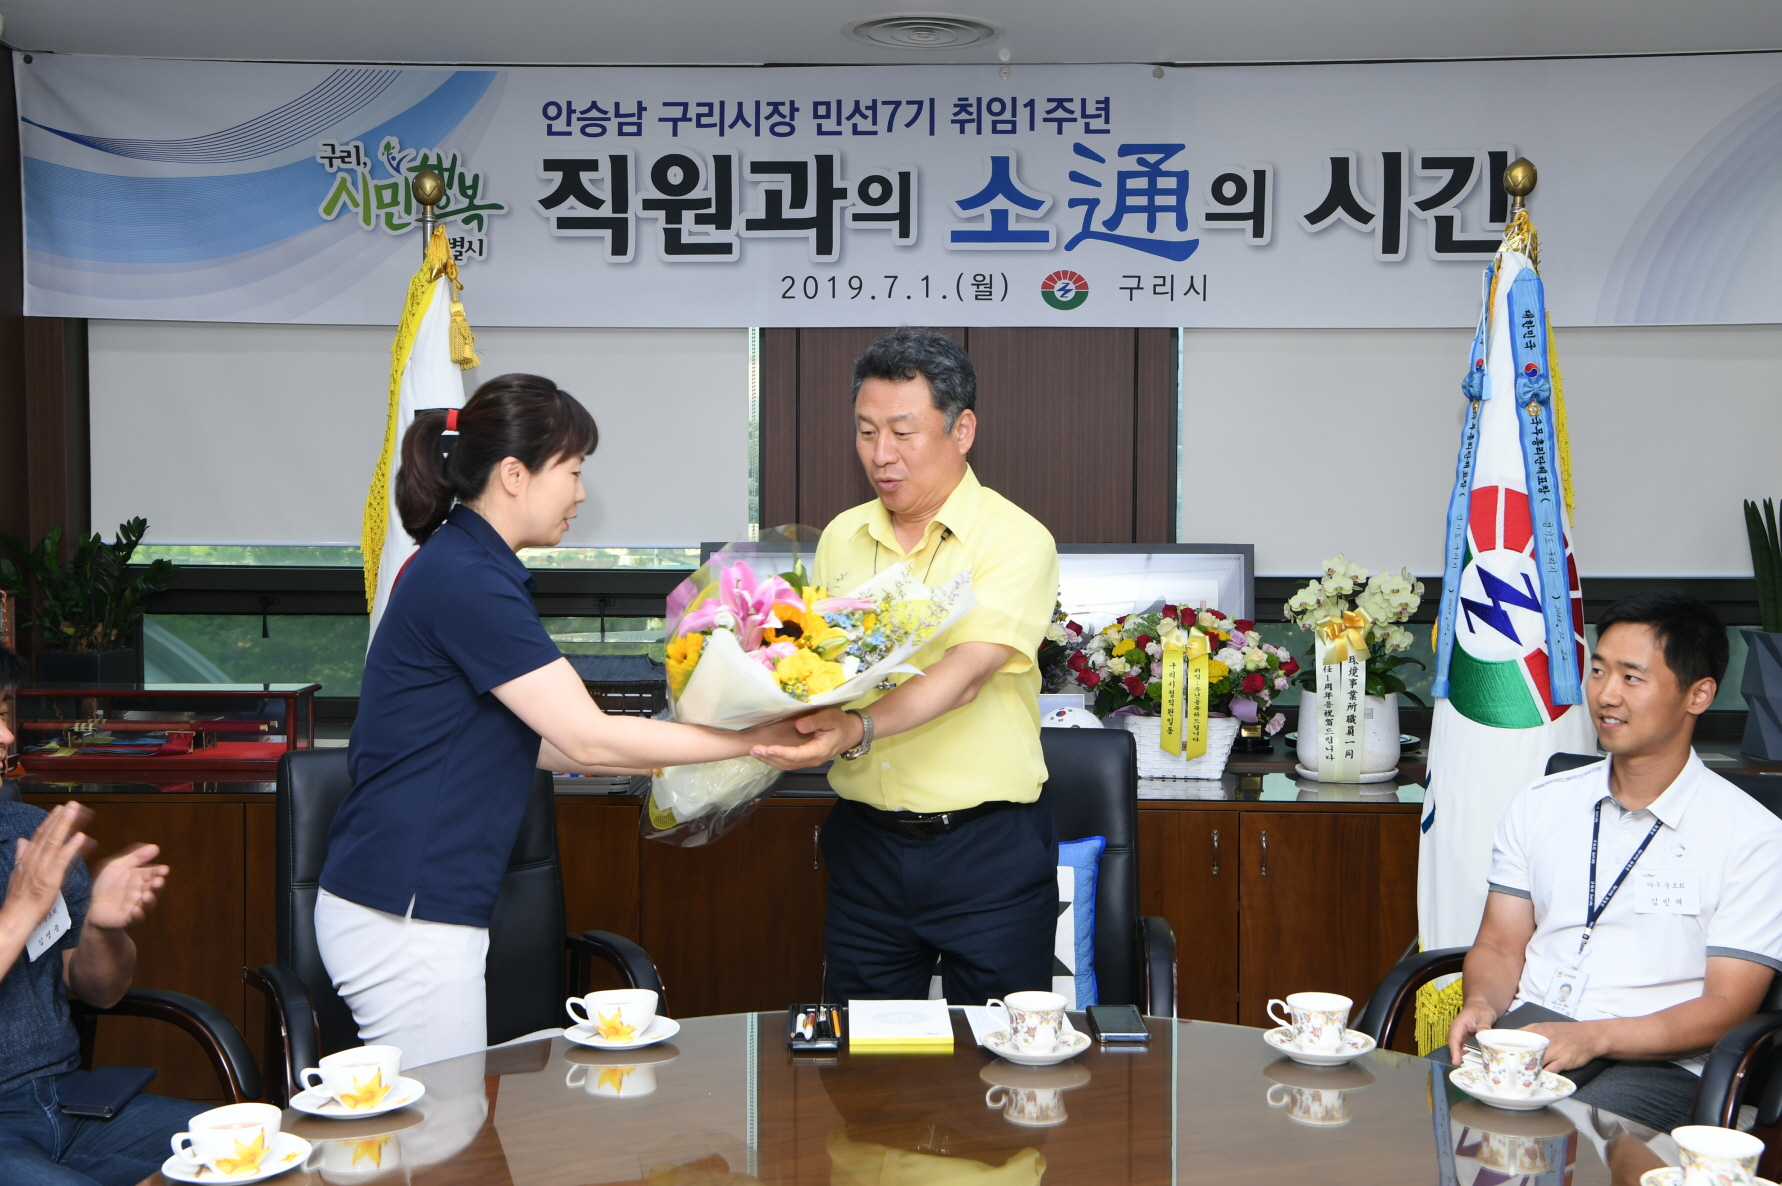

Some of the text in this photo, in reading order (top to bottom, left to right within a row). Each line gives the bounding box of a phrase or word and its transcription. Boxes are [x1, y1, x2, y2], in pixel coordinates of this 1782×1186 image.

[541, 96, 1112, 138] 안승남 구리시장 민선7기 취임1주년
[319, 143, 368, 169] 구리,
[537, 141, 1510, 262] 직원과의 소通의 시간
[447, 236, 484, 261] 별시
[780, 272, 1209, 303] 2019.7.1.(월) 구리시
[1521, 309, 1537, 351] 대한민국
